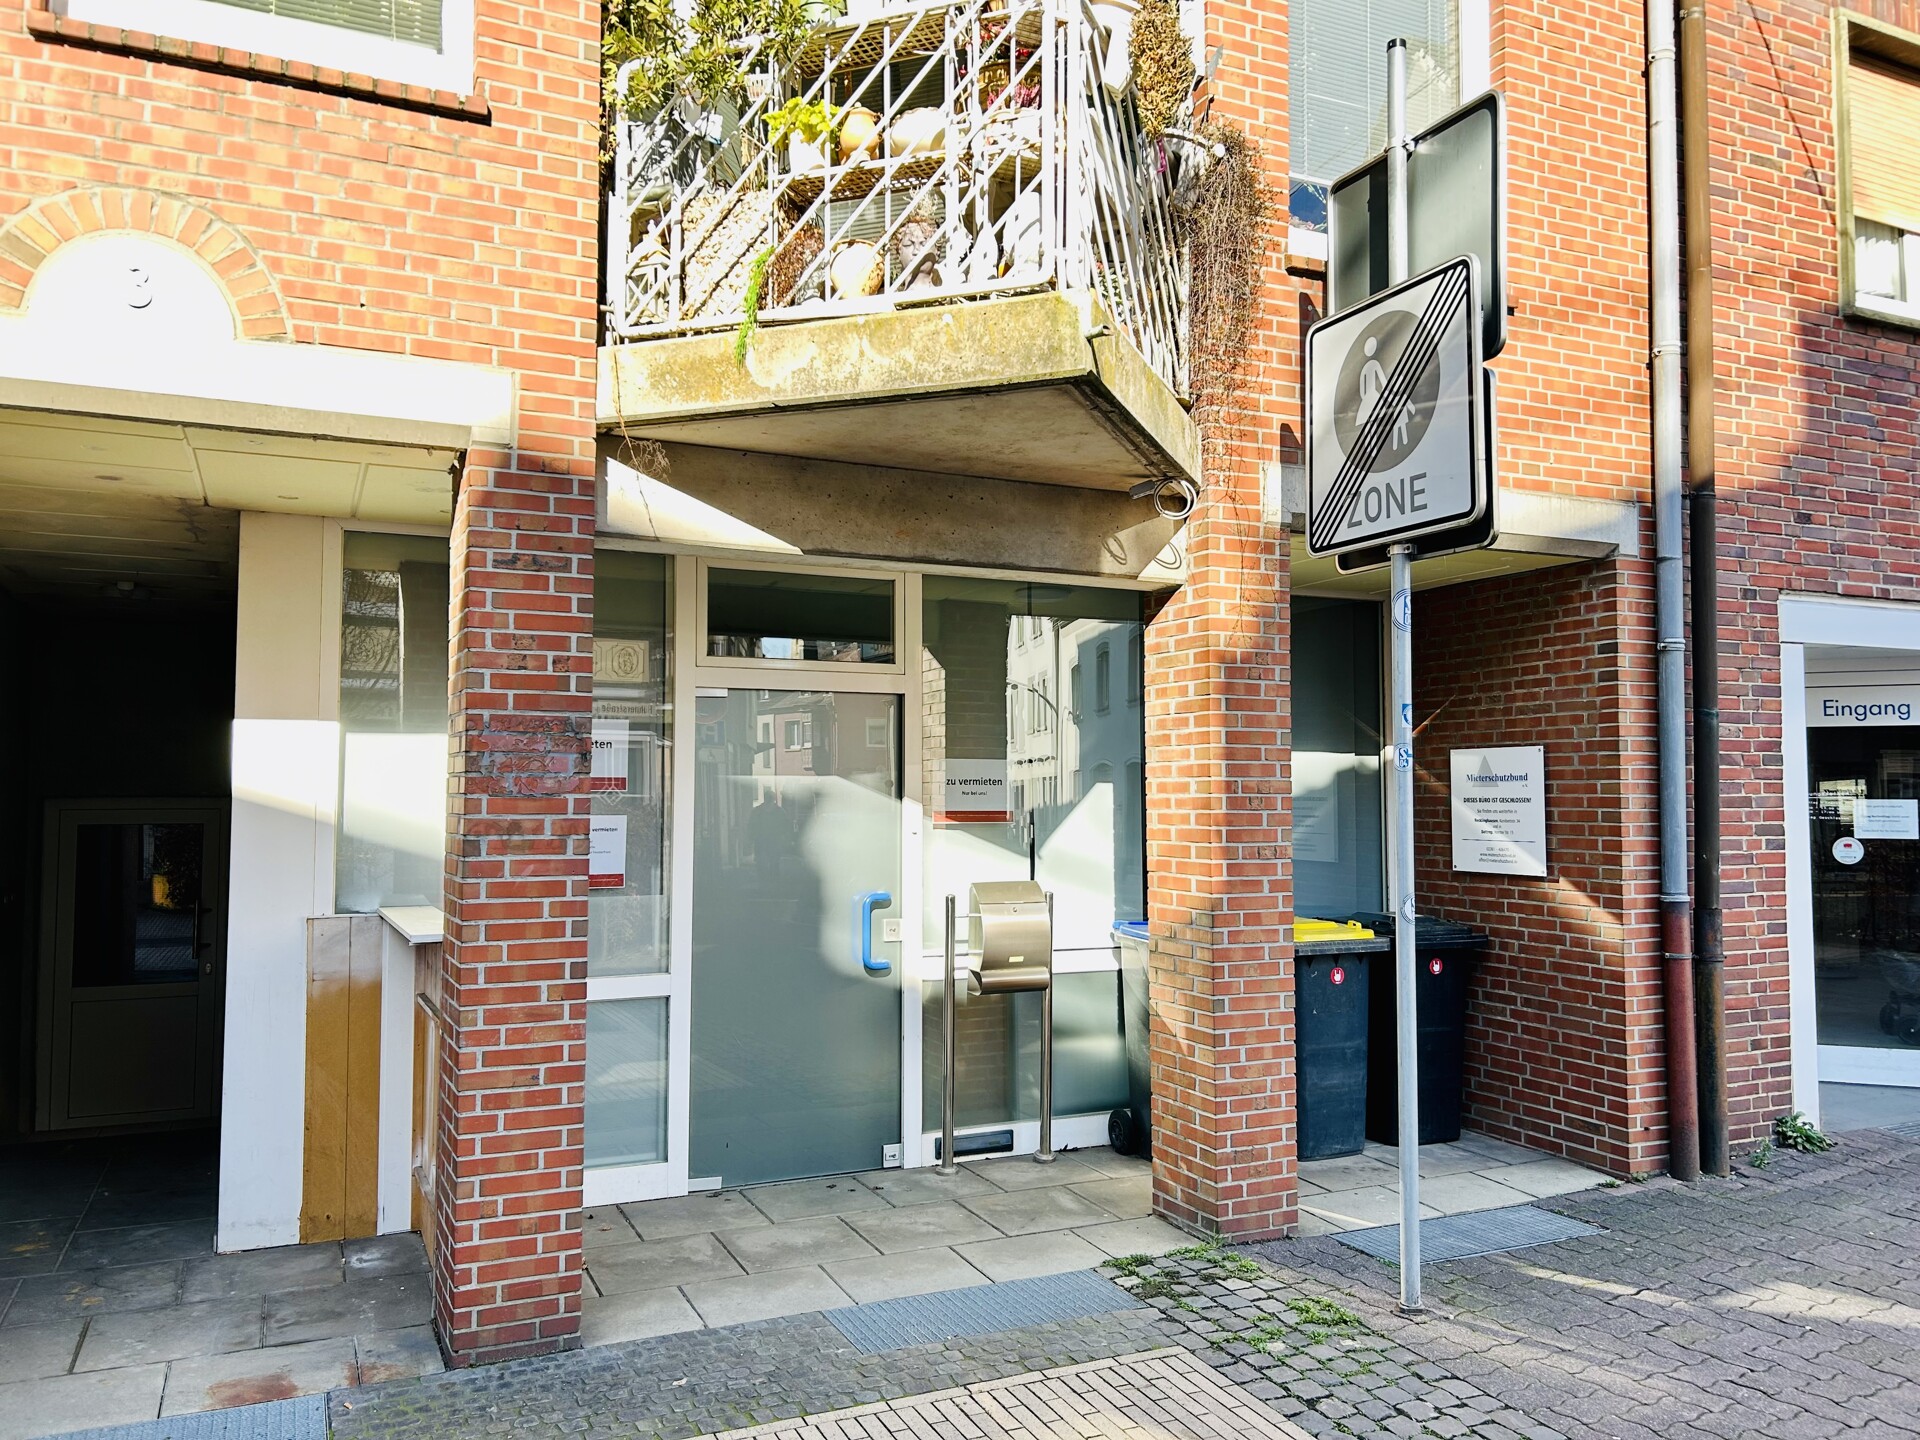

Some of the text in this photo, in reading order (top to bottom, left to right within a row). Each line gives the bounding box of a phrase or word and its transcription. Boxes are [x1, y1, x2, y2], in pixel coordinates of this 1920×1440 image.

[1345, 472, 1428, 529] ZONE
[1823, 700, 1911, 722] Eingang
[946, 777, 1003, 786] zu vermieten
[1466, 772, 1528, 782] Mieterschutzbund
